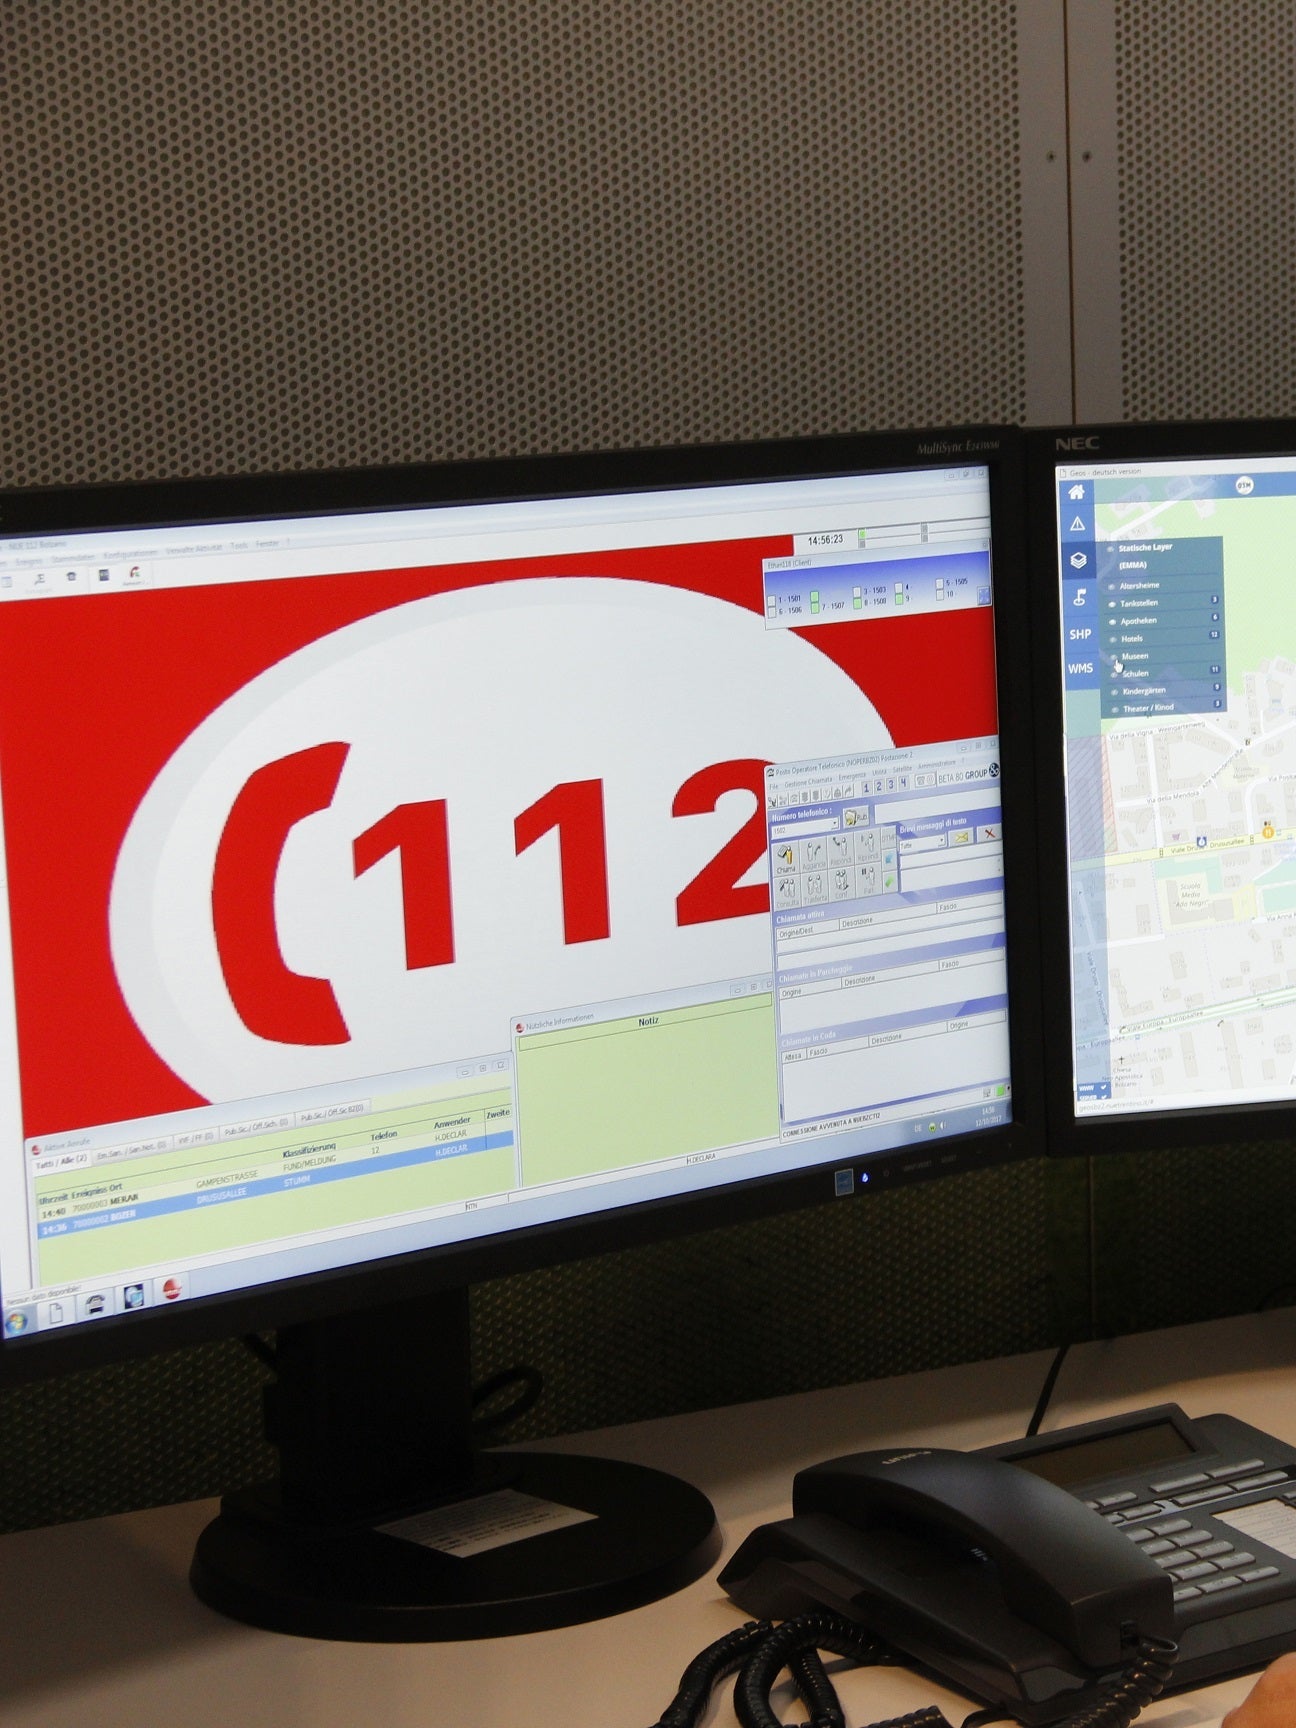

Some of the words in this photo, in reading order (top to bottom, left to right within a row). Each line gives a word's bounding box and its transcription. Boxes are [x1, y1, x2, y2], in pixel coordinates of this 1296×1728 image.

[917, 440, 962, 456] MultiSync
[1055, 436, 1100, 452] NEC
[1237, 481, 1252, 490] OSM
[808, 534, 844, 546] 14:56:23
[1119, 543, 1152, 554] Statische
[1153, 542, 1174, 554] Layer
[1119, 560, 1148, 572] (EMMA)
[1120, 581, 1160, 591] Altersheime
[1120, 598, 1158, 608] Tankstellen
[1120, 616, 1157, 628] Apotheken
[1069, 629, 1092, 641] SHP
[1121, 633, 1144, 643] Hotels
[1122, 652, 1149, 662] Museen
[1068, 663, 1094, 675] WMS
[1123, 668, 1149, 679] Schulen
[1123, 685, 1167, 697] Kindergärten
[1123, 703, 1149, 714] Theater
[792, 765, 818, 776] Operatore
[819, 762, 845, 772] Telefonico
[785, 779, 808, 789] Gestione
[808, 776, 833, 786] Chiamata
[839, 771, 867, 782] Emergenza
[901, 778, 906, 787] 4
[938, 774, 954, 784] BETA
[965, 769, 988, 781] GROUP
[863, 783, 869, 793] 1
[876, 781, 881, 791] 2
[888, 779, 893, 789] 3
[772, 812, 797, 823] Numero
[798, 807, 828, 818] telefonico
[953, 817, 967, 826] testo
[353, 758, 770, 970] 112
[940, 902, 958, 911] Fascio
[776, 913, 806, 924] Chiamata
[842, 916, 873, 928] Descrizione
[942, 959, 959, 968] Fascio
[844, 974, 875, 986] Descrizione
[782, 988, 802, 998] Origine
[638, 1015, 659, 1028] Notiz
[950, 1019, 969, 1030] Origine
[781, 1036, 811, 1048] Chiamate
[820, 1031, 836, 1041] Coda
[871, 1032, 902, 1045] Descrizione
[809, 1047, 828, 1057] Fascio
[486, 1107, 511, 1119] Zweite
[433, 1116, 471, 1129] Anwender
[782, 1125, 819, 1138] CONNESSIONE
[819, 1120, 847, 1130] AVVENUTA
[371, 1130, 397, 1141] Telefon
[282, 1142, 337, 1158] Klassifizierung
[76, 1154, 88, 1163] (2)
[110, 1193, 139, 1205] MERAN
[196, 1170, 259, 1189] GAMPENSTRASSE
[283, 1155, 337, 1172] FUND/MELDUNG
[371, 1146, 380, 1155] 12
[283, 1175, 311, 1188] STUMM
[109, 1184, 123, 1192] Ort
